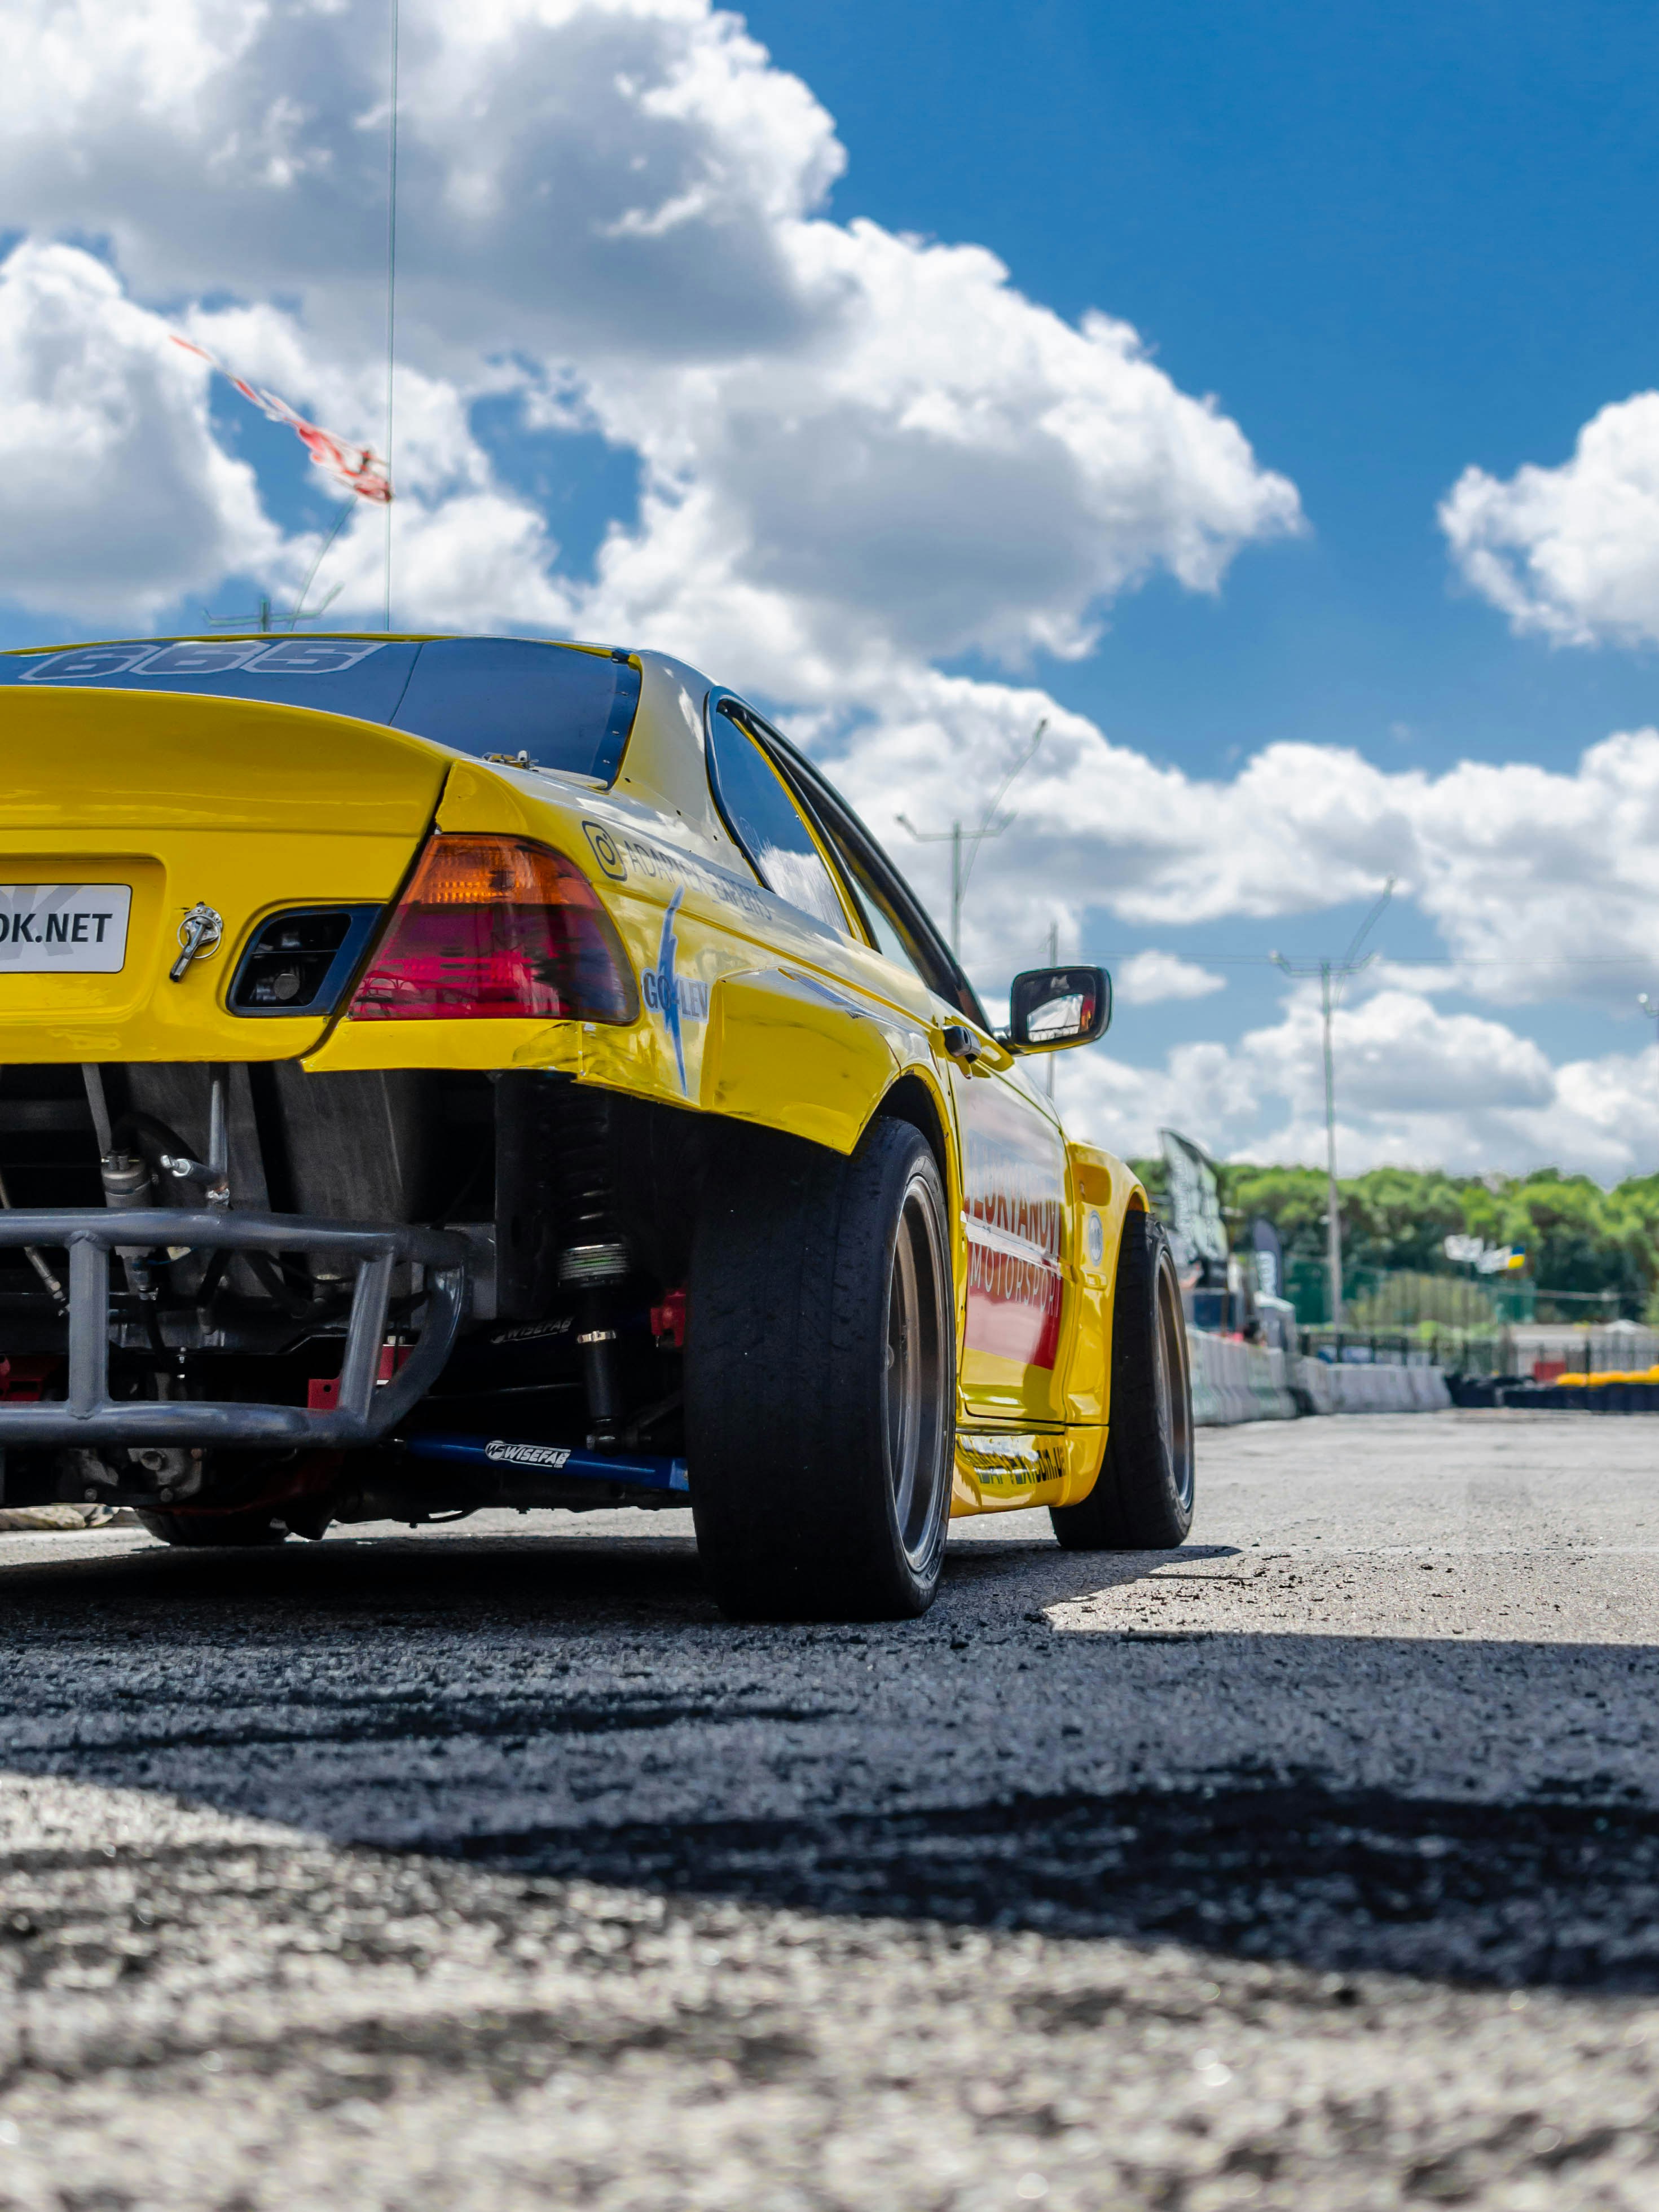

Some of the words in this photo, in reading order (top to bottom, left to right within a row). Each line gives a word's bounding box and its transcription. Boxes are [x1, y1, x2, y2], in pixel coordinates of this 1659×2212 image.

[18, 639, 389, 681] 665
[969, 1241, 1062, 1318] MOTORSPORT
[504, 1446, 570, 1465] WISEFAB
